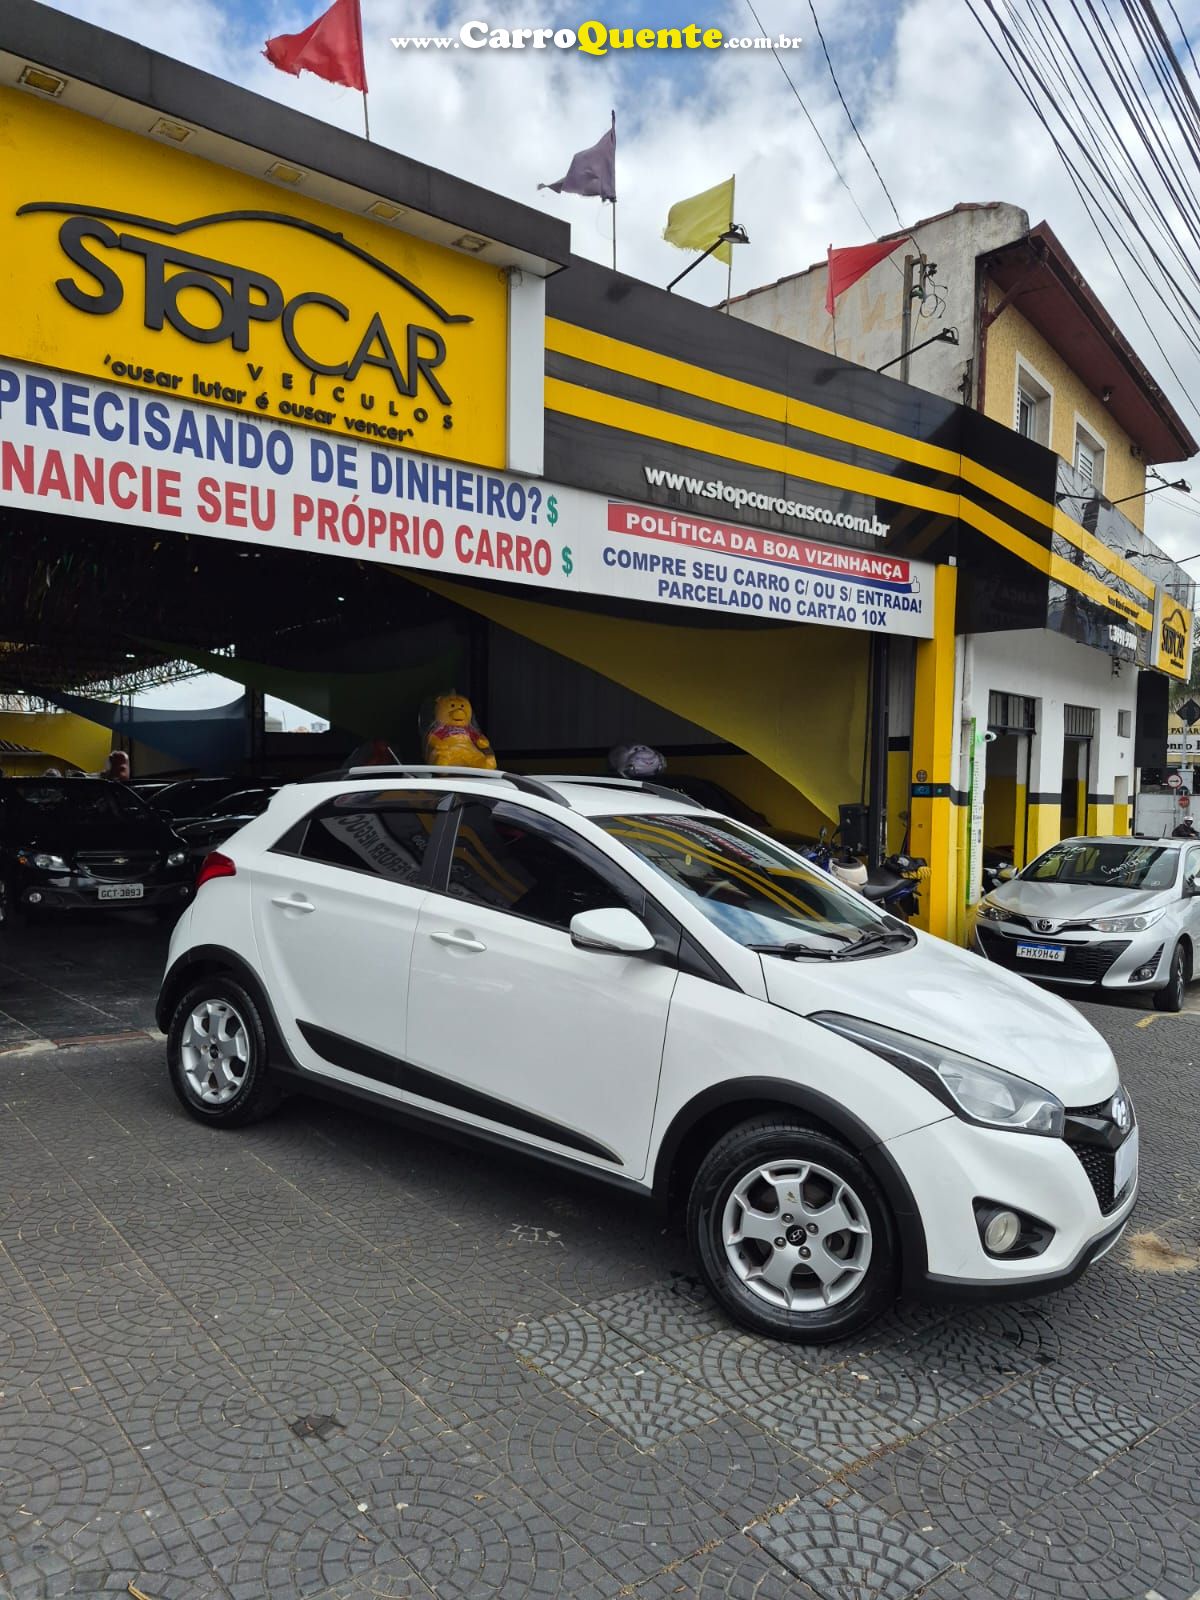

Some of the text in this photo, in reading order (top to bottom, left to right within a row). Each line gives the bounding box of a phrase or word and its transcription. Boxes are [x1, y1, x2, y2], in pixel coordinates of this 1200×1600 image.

[55, 215, 453, 406] STOPCAR
[192, 373, 247, 405] lutar
[255, 392, 270, 410] é
[278, 399, 337, 426] ousar
[247, 363, 453, 430] VEÍCULOS
[0, 369, 294, 475] PRECISANDO
[311, 438, 358, 490] DE
[371, 452, 542, 525] DINHEIRO?
[2, 440, 183, 518] NANCIE
[197, 476, 276, 531] SEU
[293, 494, 444, 559] PRÓPRIO
[455, 524, 552, 576] CARRO
[643, 465, 891, 539] www.stopcarosasco.com.br
[602, 546, 922, 614] COMPRE SEU CARRO C/ OU S/ ENTRADA!
[626, 512, 903, 580] POLÍTICA DA BOA VIZINHANÇA
[657, 579, 763, 610] PARCELADO
[769, 594, 792, 614] NO
[861, 609, 887, 626] 10X
